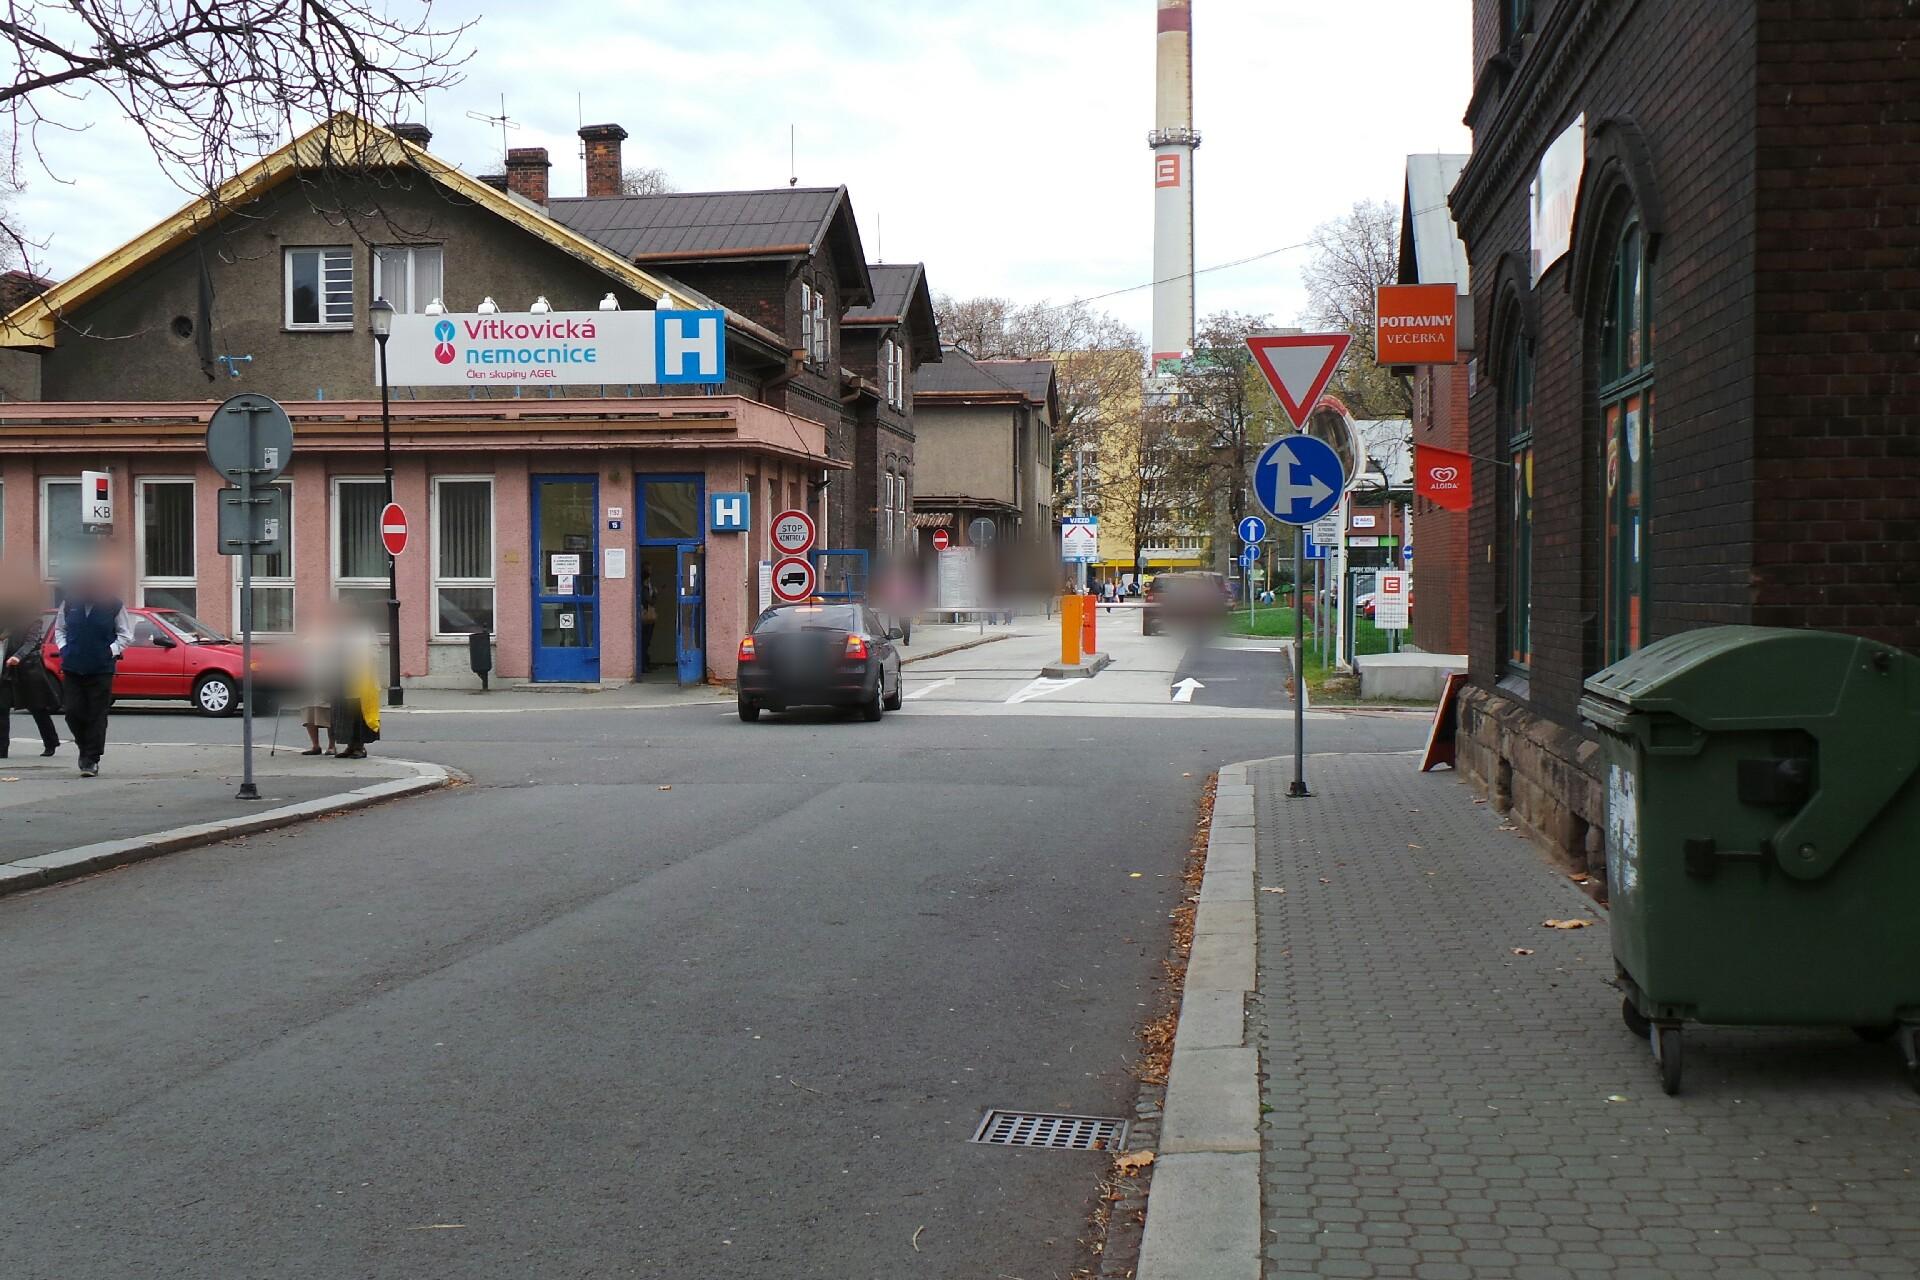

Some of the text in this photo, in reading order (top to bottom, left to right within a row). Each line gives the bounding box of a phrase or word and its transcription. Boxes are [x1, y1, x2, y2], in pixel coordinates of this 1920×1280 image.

[1380, 315, 1453, 328] POTRAVINY
[464, 318, 596, 340] Vítkovická
[1386, 333, 1446, 344] VEČERKA
[664, 318, 717, 375] H
[466, 343, 596, 364] nemocnice
[466, 369, 557, 380] Člen skupiny AGEL
[93, 506, 111, 518] KB
[716, 499, 740, 526] H
[781, 524, 803, 533] STOP
